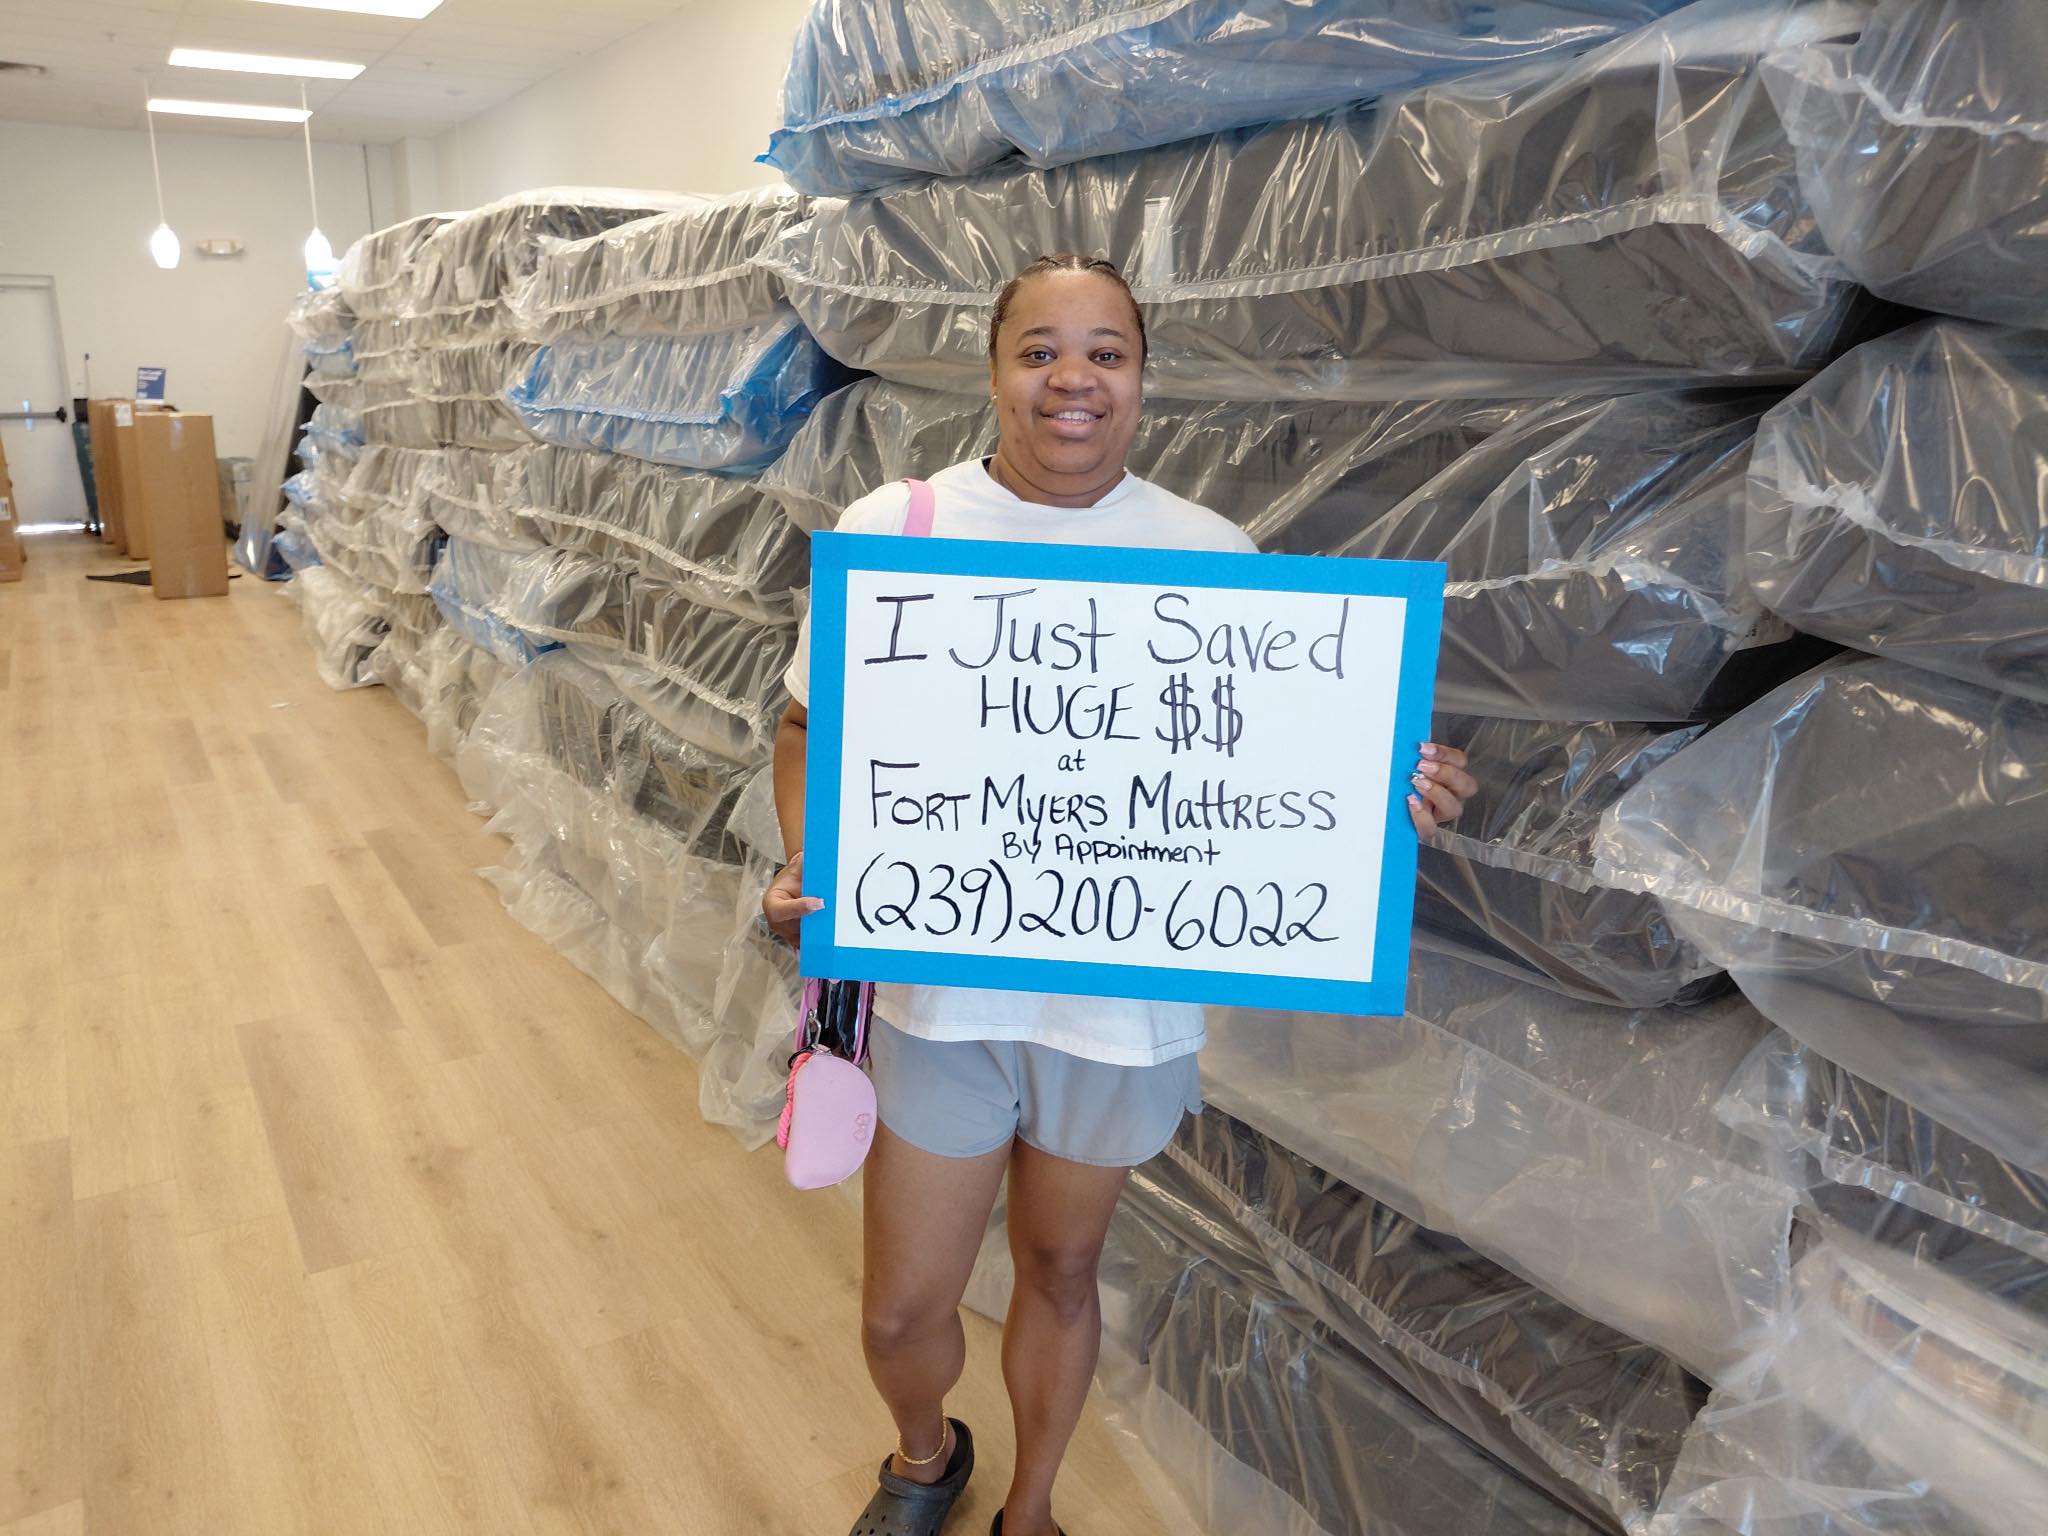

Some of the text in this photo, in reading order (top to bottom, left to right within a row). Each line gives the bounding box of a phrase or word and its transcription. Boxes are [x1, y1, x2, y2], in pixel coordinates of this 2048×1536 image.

[864, 587, 1350, 681] I Just Saved
[980, 671, 1244, 759] HUGE $$
[869, 759, 972, 833] FORT
[1057, 747, 1087, 773] at
[1001, 830, 1222, 867] By Appointment
